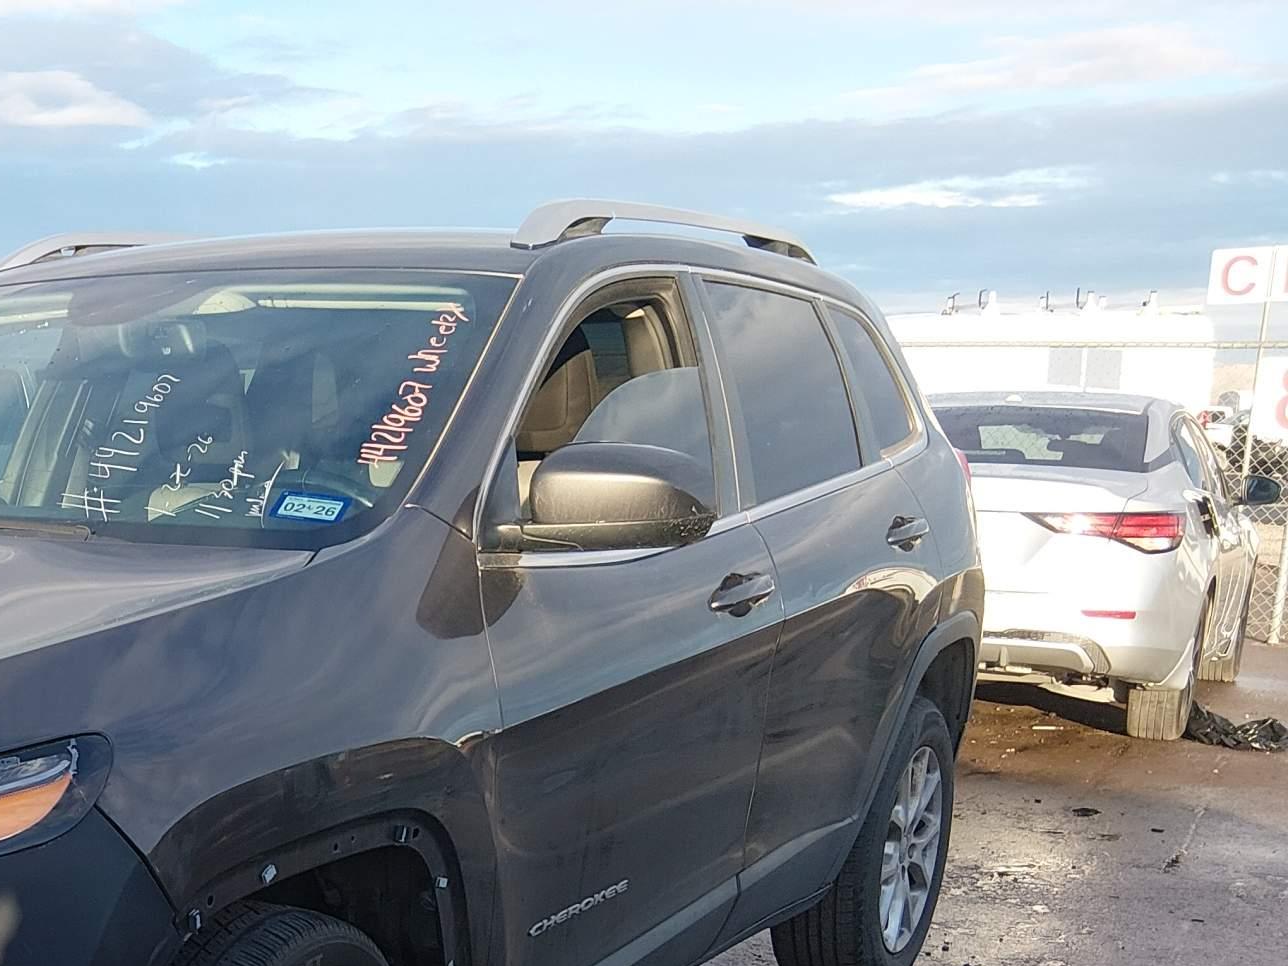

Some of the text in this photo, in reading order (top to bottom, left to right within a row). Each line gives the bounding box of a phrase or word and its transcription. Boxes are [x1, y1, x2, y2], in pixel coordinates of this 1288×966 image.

[356, 379, 433, 469] 44219607
[313, 505, 337, 517] 26
[528, 878, 630, 937] CHEROKEE
